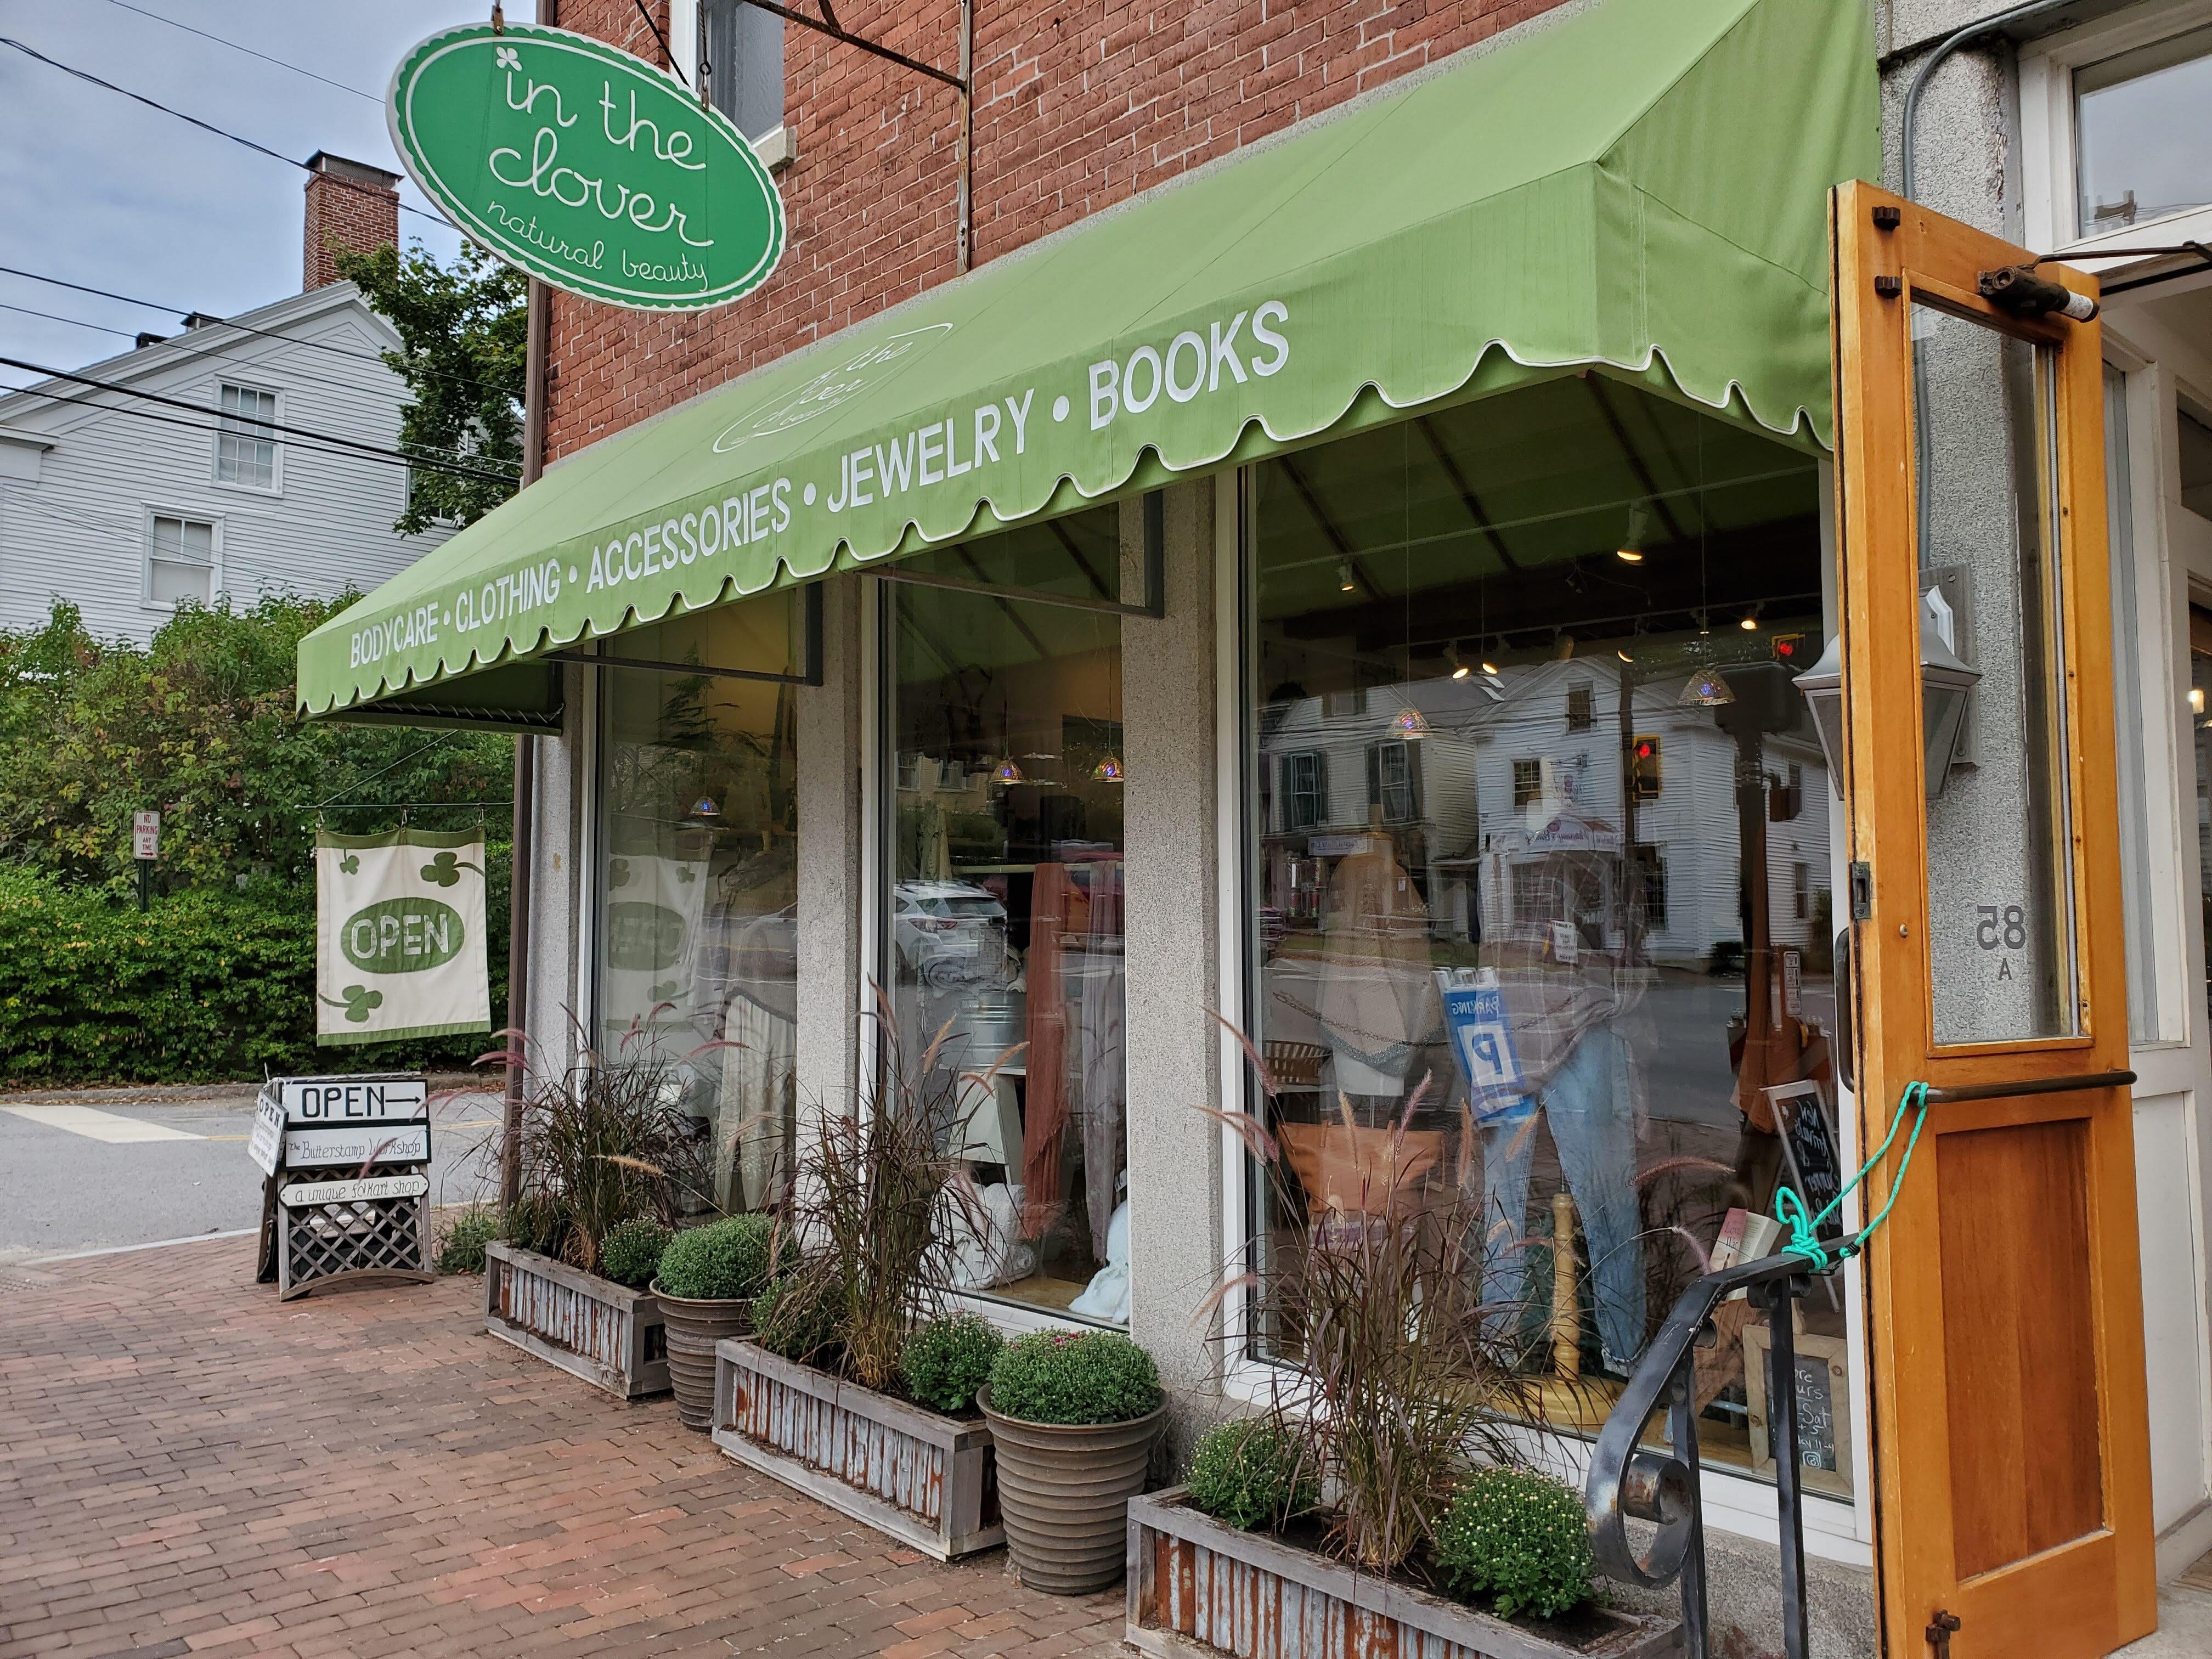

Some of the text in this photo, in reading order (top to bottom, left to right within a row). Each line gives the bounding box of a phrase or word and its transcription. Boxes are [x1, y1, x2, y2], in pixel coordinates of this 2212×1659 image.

[506, 71, 707, 170] in the
[489, 127, 714, 247] clover
[487, 200, 708, 292] natural beauty
[350, 300, 1290, 669] BODYCARE CLOTHING ACCESSORIES JEWELRY BOOKS
[137, 825, 157, 834] PARKING
[144, 814, 151, 823] NO
[351, 913, 449, 959] OPEN
[259, 1098, 280, 1128] OPEN
[302, 1086, 385, 1118] OPEN
[302, 1141, 365, 1159] Butterstamp
[295, 1190, 303, 1202] a
[308, 1187, 346, 1203] unique
[392, 1180, 419, 1195] shop
